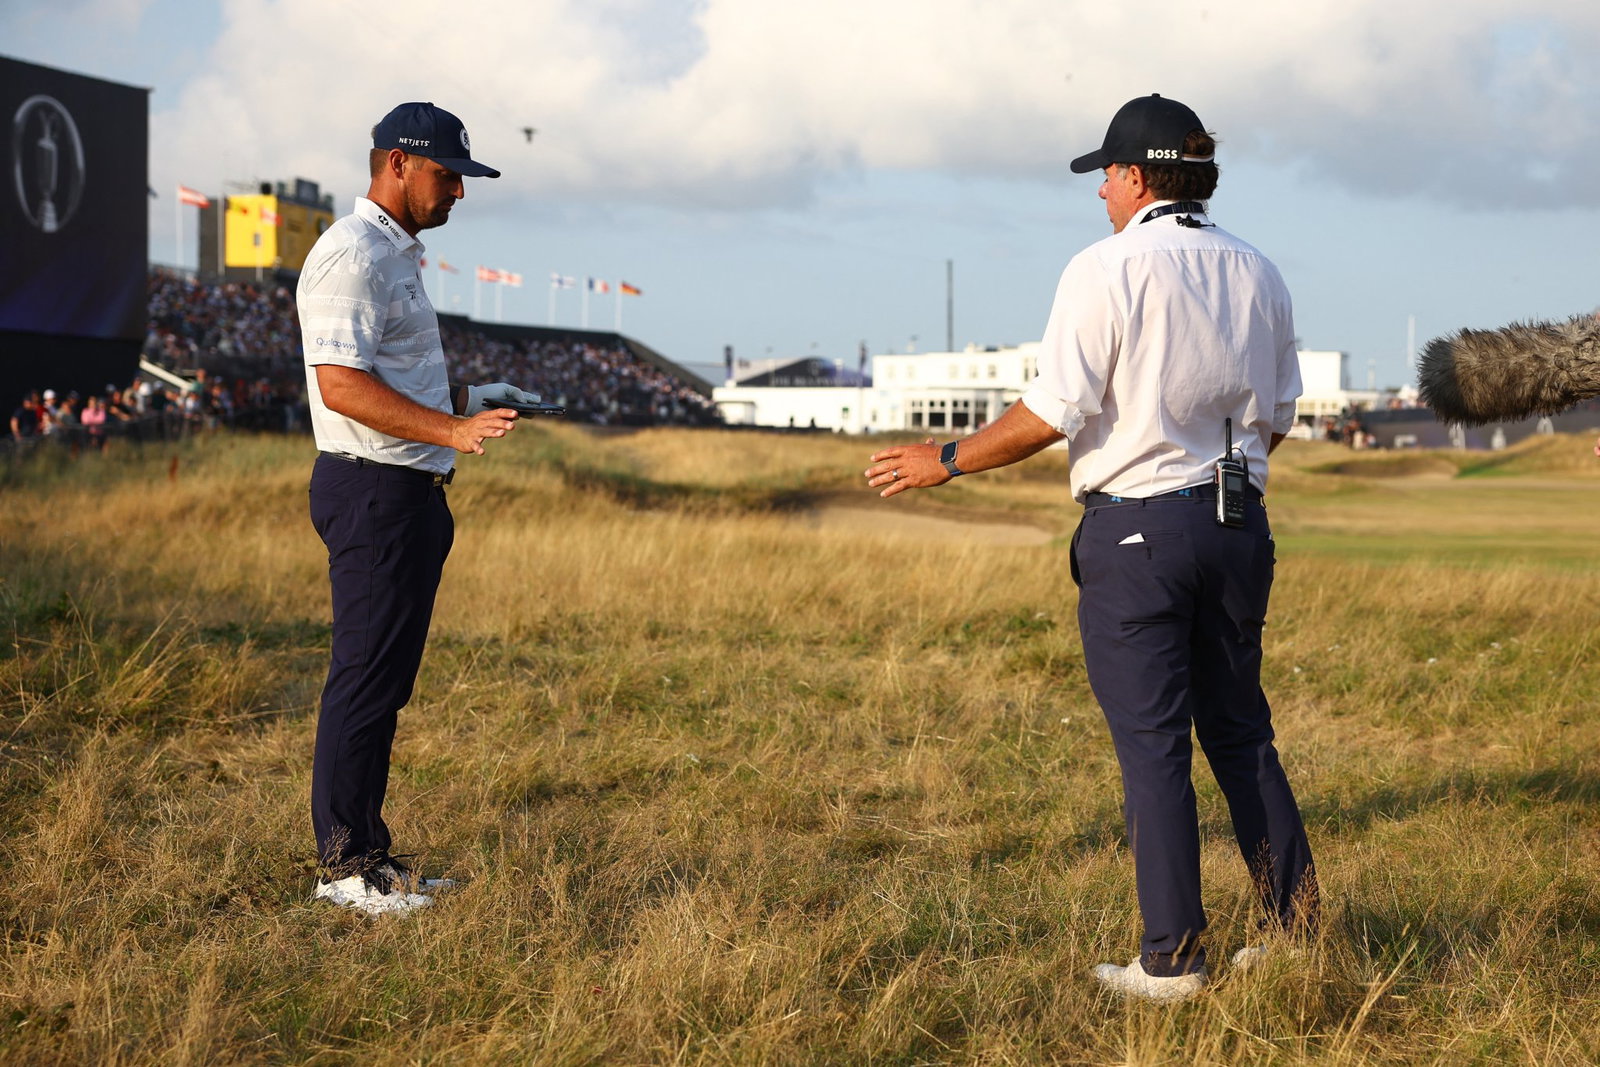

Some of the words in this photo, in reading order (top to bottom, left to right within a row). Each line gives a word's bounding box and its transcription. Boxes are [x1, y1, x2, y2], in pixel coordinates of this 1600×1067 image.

[398, 137, 430, 147] NETJETS
[1147, 149, 1178, 159] BOSS
[388, 225, 402, 240] HSBC
